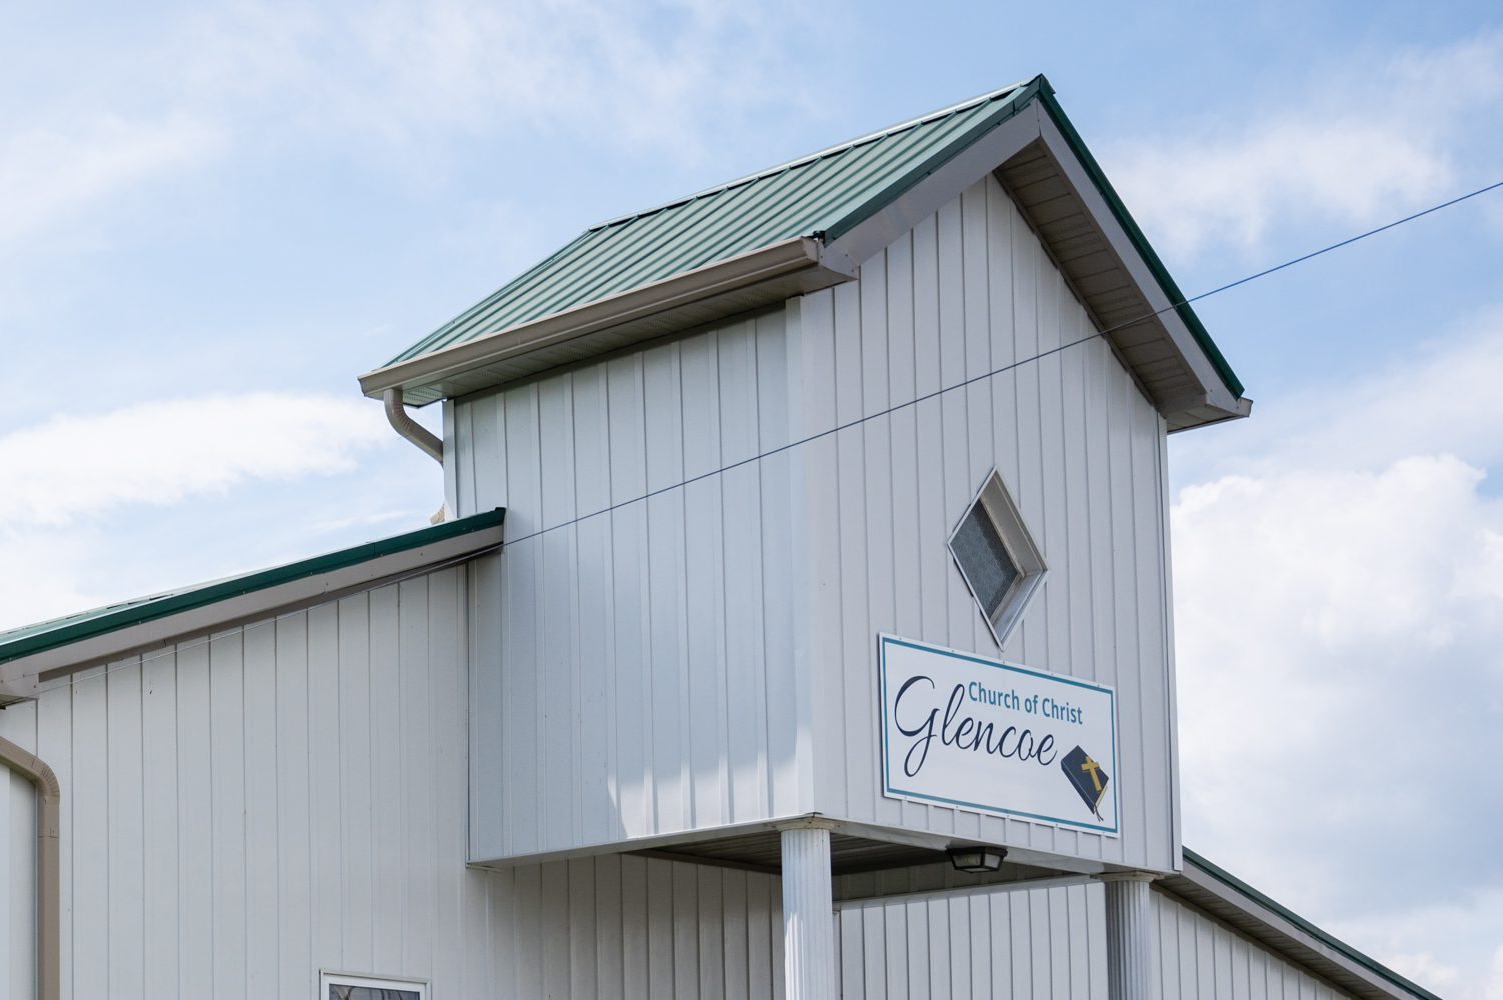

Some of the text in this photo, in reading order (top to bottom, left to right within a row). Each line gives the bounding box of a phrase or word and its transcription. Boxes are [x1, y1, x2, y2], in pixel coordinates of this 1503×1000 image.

[894, 675, 1057, 778] Glencoe
[968, 681, 1083, 725] Church of Christ
